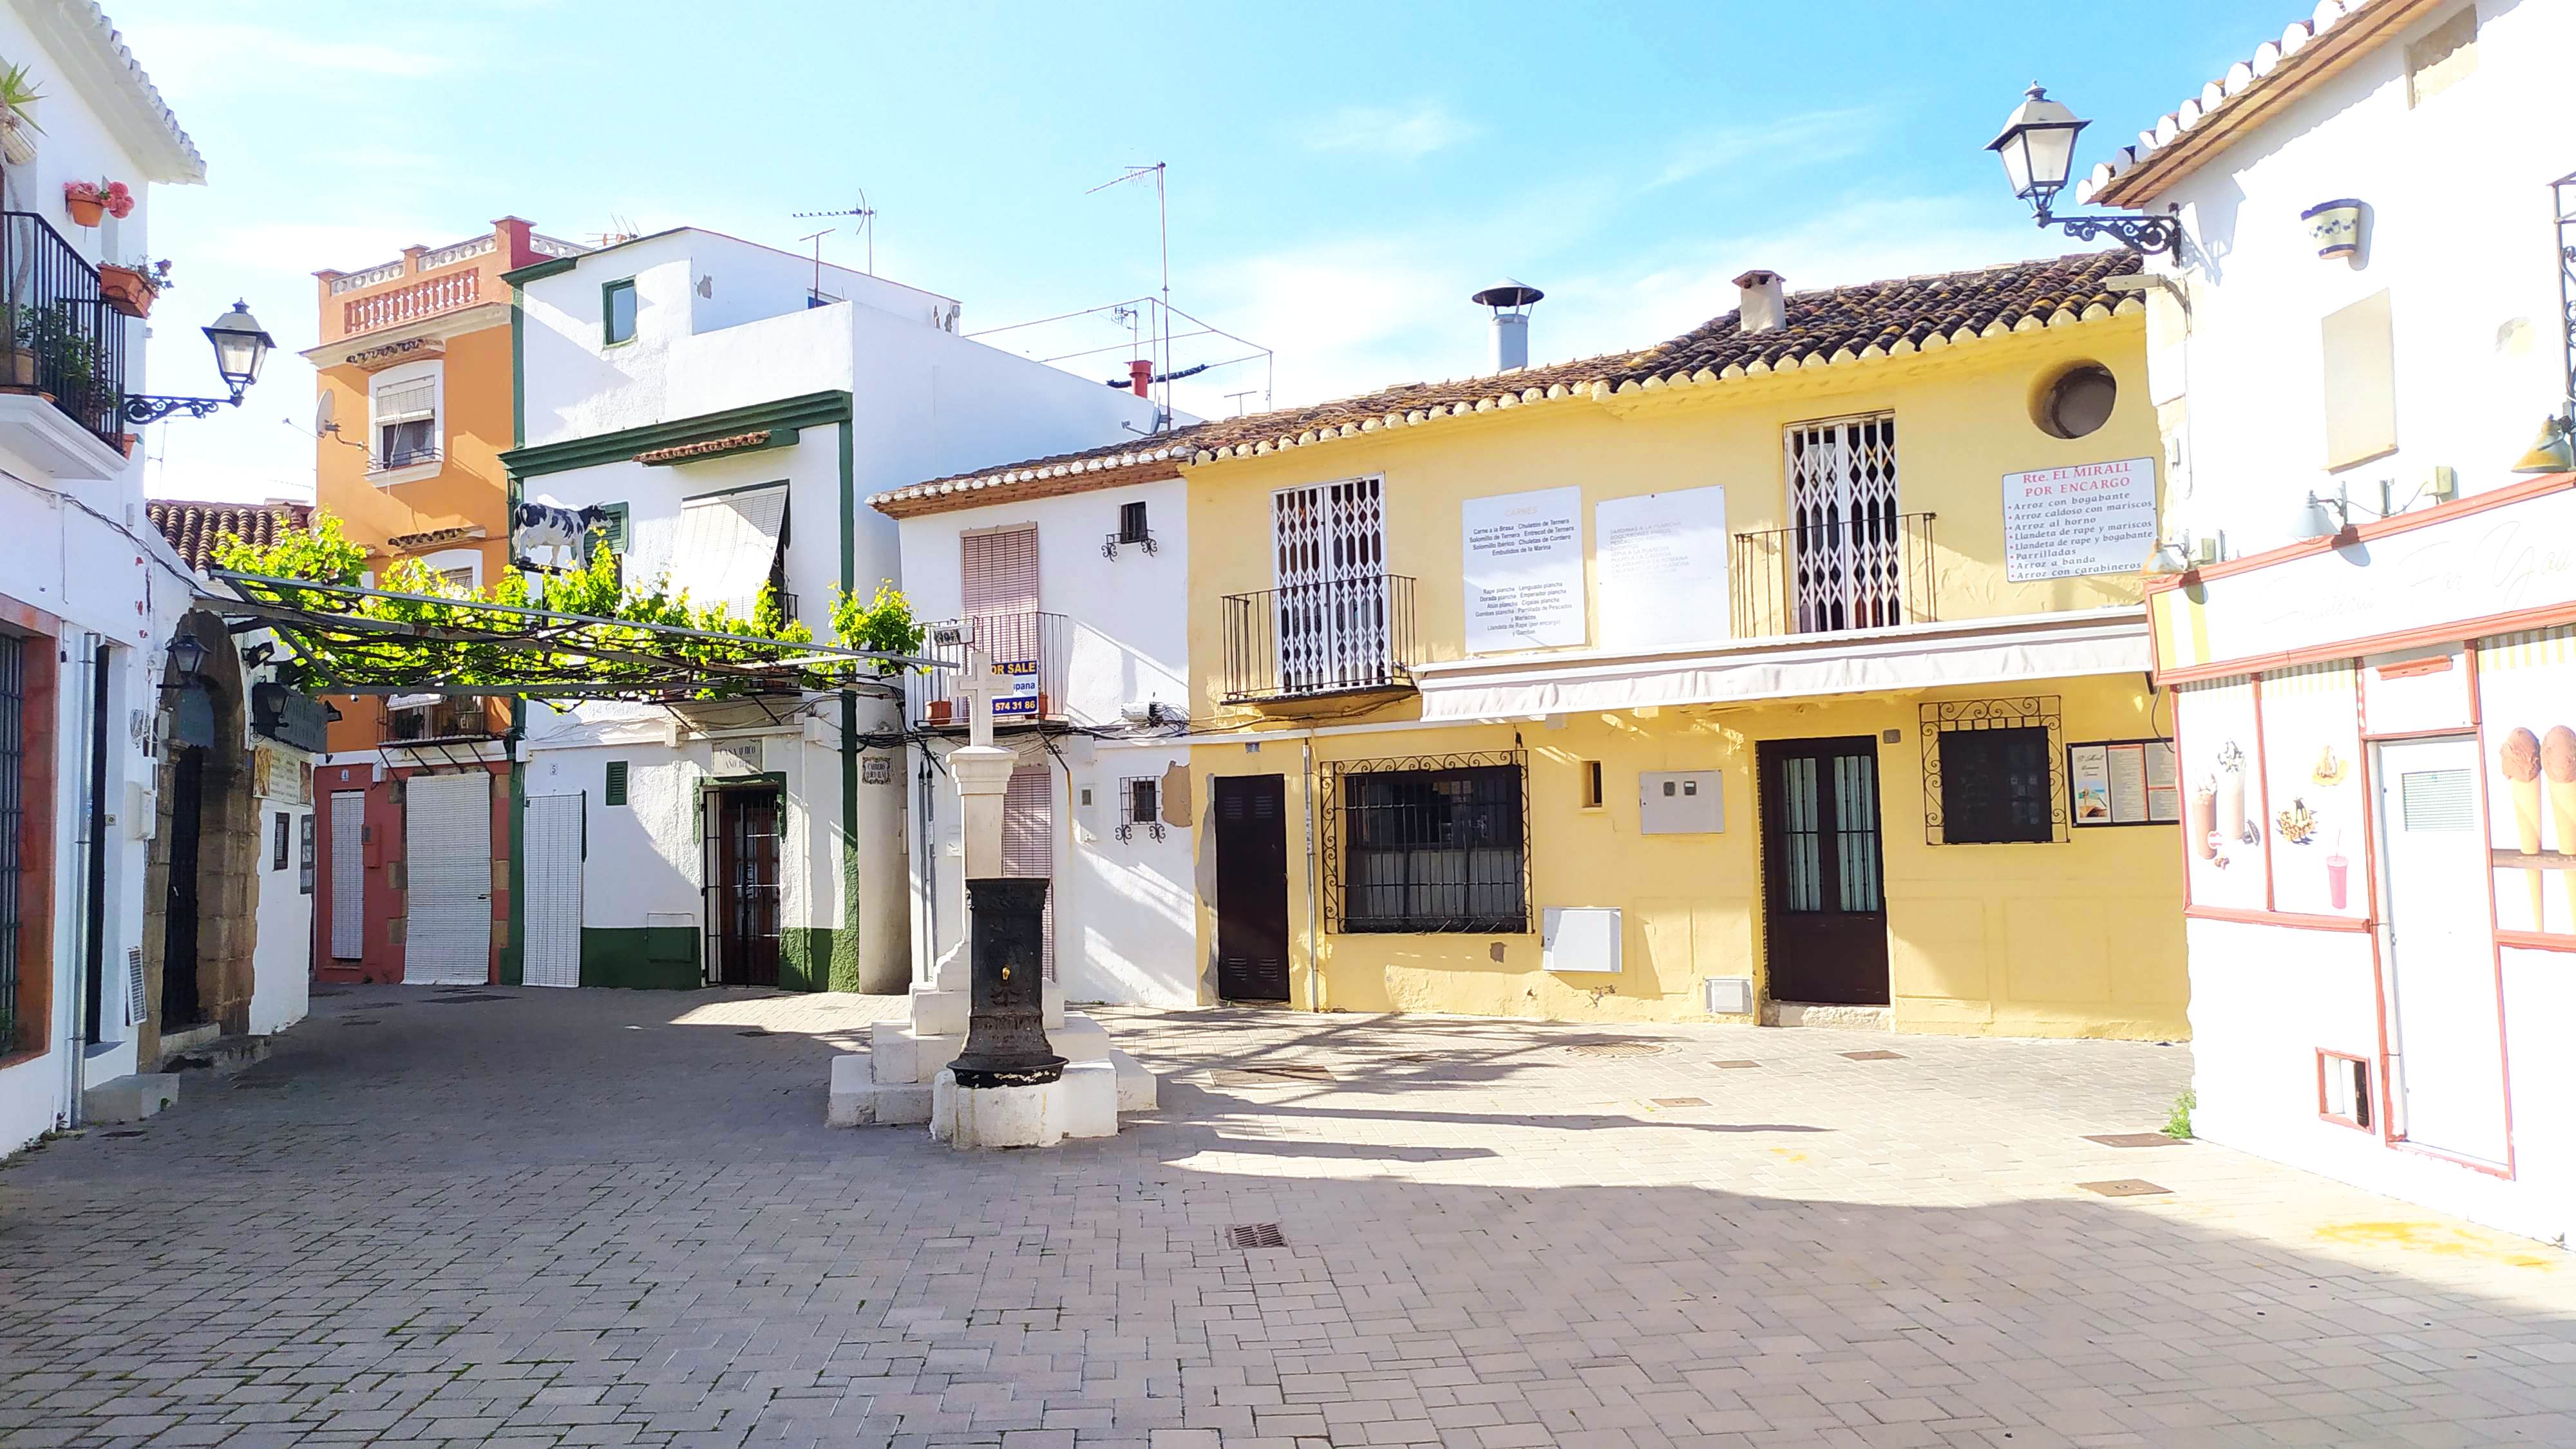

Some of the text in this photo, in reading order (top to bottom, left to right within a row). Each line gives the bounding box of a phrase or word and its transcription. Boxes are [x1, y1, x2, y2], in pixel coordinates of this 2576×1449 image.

[2023, 462, 2132, 484] Rte. EL MIRALL
[2025, 477, 2130, 497] POR ENCARGO
[2013, 502, 2043, 511] Arroz
[2072, 491, 2130, 505] bogabante
[2014, 513, 2041, 521] Arroz
[2045, 509, 2082, 518] caldoso
[2107, 500, 2152, 511] mariscos
[2014, 516, 2096, 531] Arroz al horno
[2014, 530, 2056, 540] Llandeta
[2060, 528, 2070, 536] de
[2073, 526, 2095, 536] rape
[2107, 520, 2152, 531] mariscos
[2015, 540, 2054, 551] Llandeta
[2058, 538, 2068, 547] de
[2070, 537, 2092, 547] rape
[2103, 531, 2153, 542] bogabante
[1492, 548, 1519, 556] Embutidos
[2016, 549, 2076, 560] Parrilladas
[2016, 562, 2046, 570] Arroz
[2062, 556, 2096, 565] banda
[2017, 571, 2047, 580] Arroz
[2075, 562, 2141, 575] carabineros
[990, 663, 1036, 675] OR SALE
[995, 701, 1036, 711] 574 31 86
